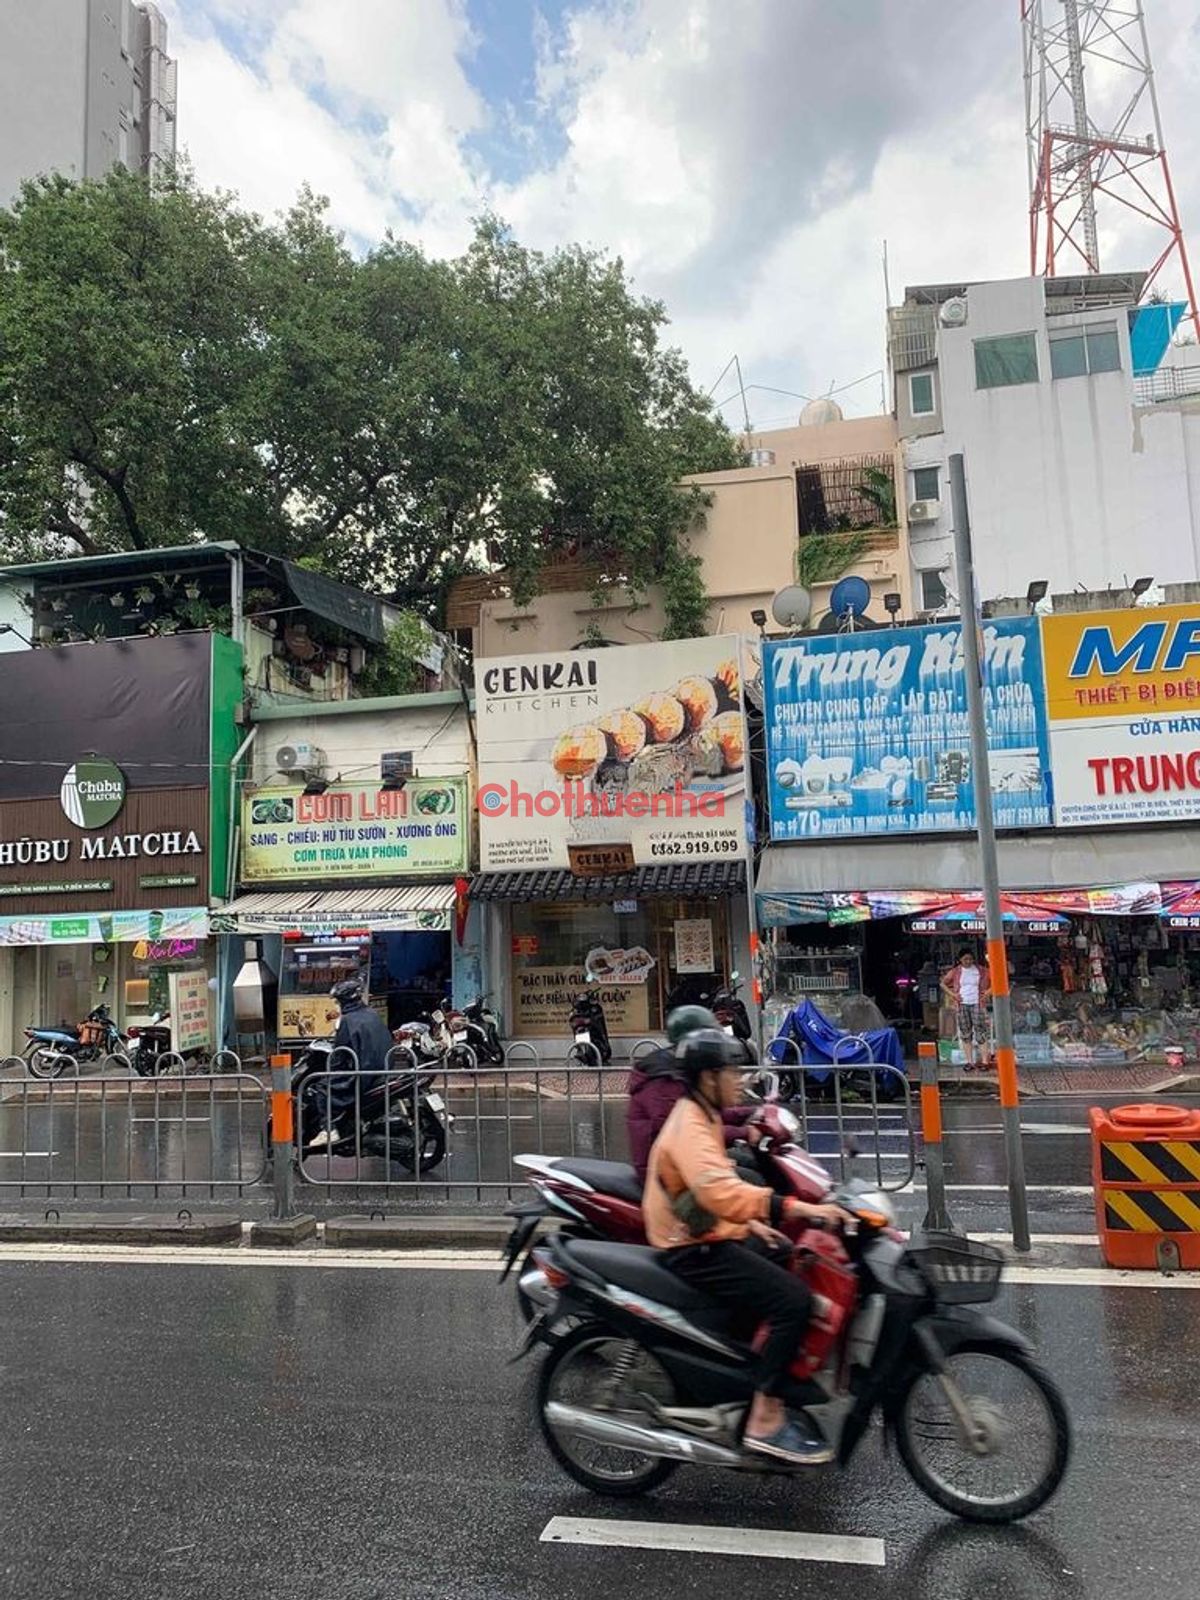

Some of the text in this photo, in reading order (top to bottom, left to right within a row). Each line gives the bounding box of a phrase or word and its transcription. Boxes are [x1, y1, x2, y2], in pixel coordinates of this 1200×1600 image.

[483, 660, 597, 694] GENKAI
[772, 645, 910, 688] Trung
[486, 695, 598, 714] KITCHEN
[1075, 681, 1130, 706] THIẾT
[1138, 683, 1158, 706] BỊ
[774, 698, 822, 720] CHUYÊN
[826, 699, 860, 717] CUNG
[1130, 717, 1162, 736] CỬA
[1087, 751, 1200, 796] TRUNG
[87, 793, 122, 801] MATCHA
[799, 810, 820, 832] 70
[80, 830, 202, 859] MATCHA
[1028, 921, 1059, 932] CHIN-SU
